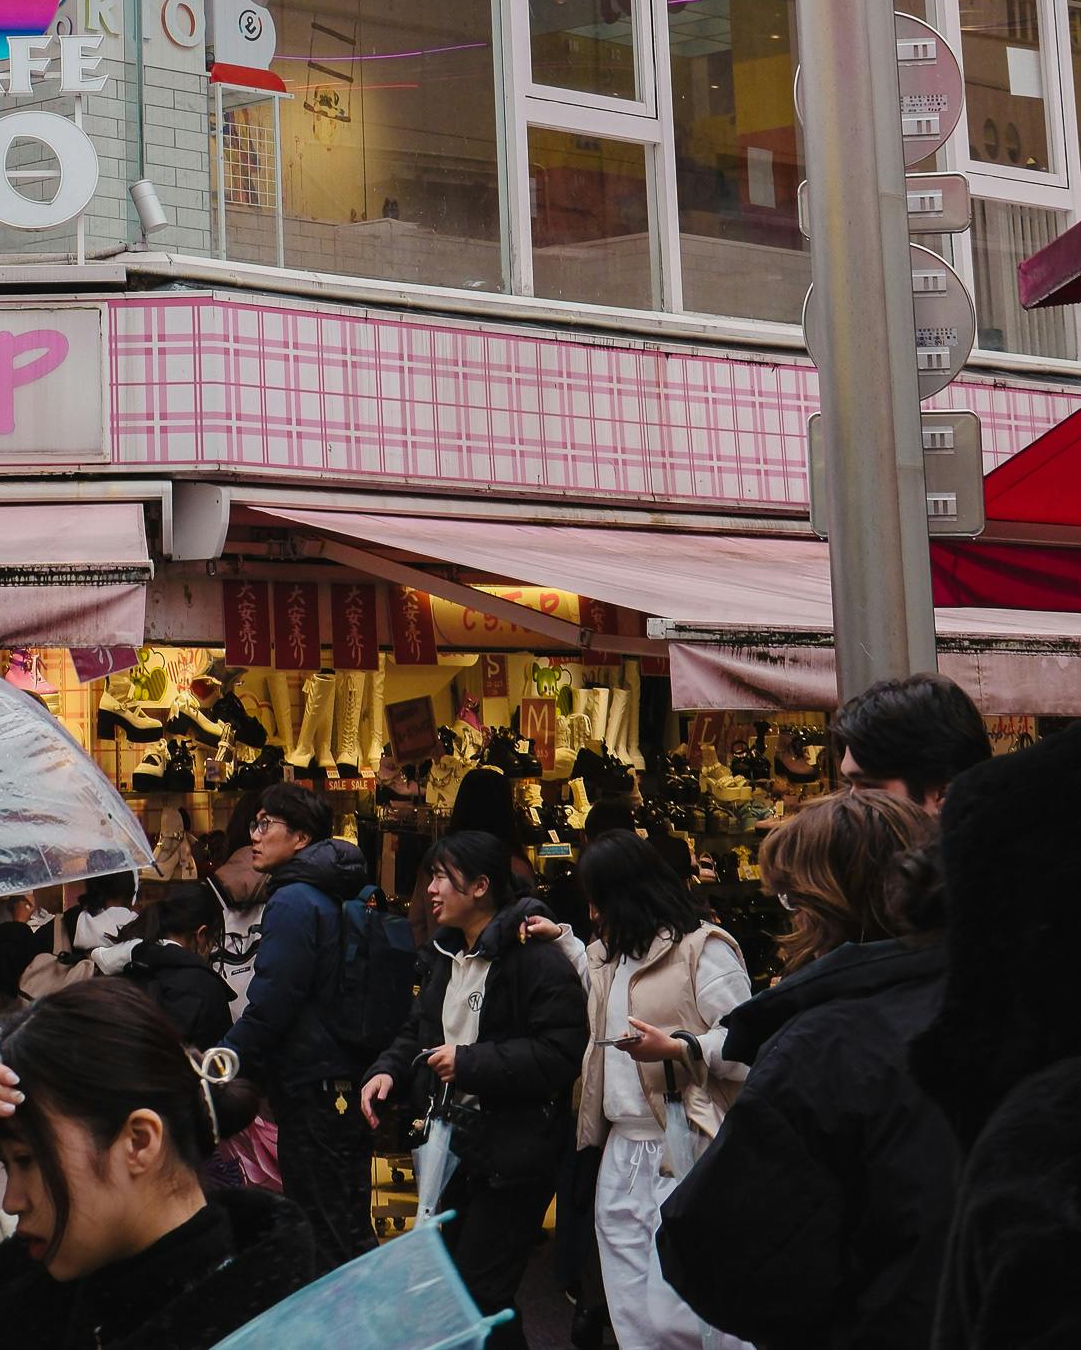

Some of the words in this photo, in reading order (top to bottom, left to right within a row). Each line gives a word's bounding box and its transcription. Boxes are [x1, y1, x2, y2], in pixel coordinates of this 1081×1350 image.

[236, 583, 257, 665] 大安売り
[288, 585, 307, 668] 大安売り
[346, 585, 364, 668] 大安売り
[329, 781, 346, 790] SALE
[351, 781, 368, 790] SALE
